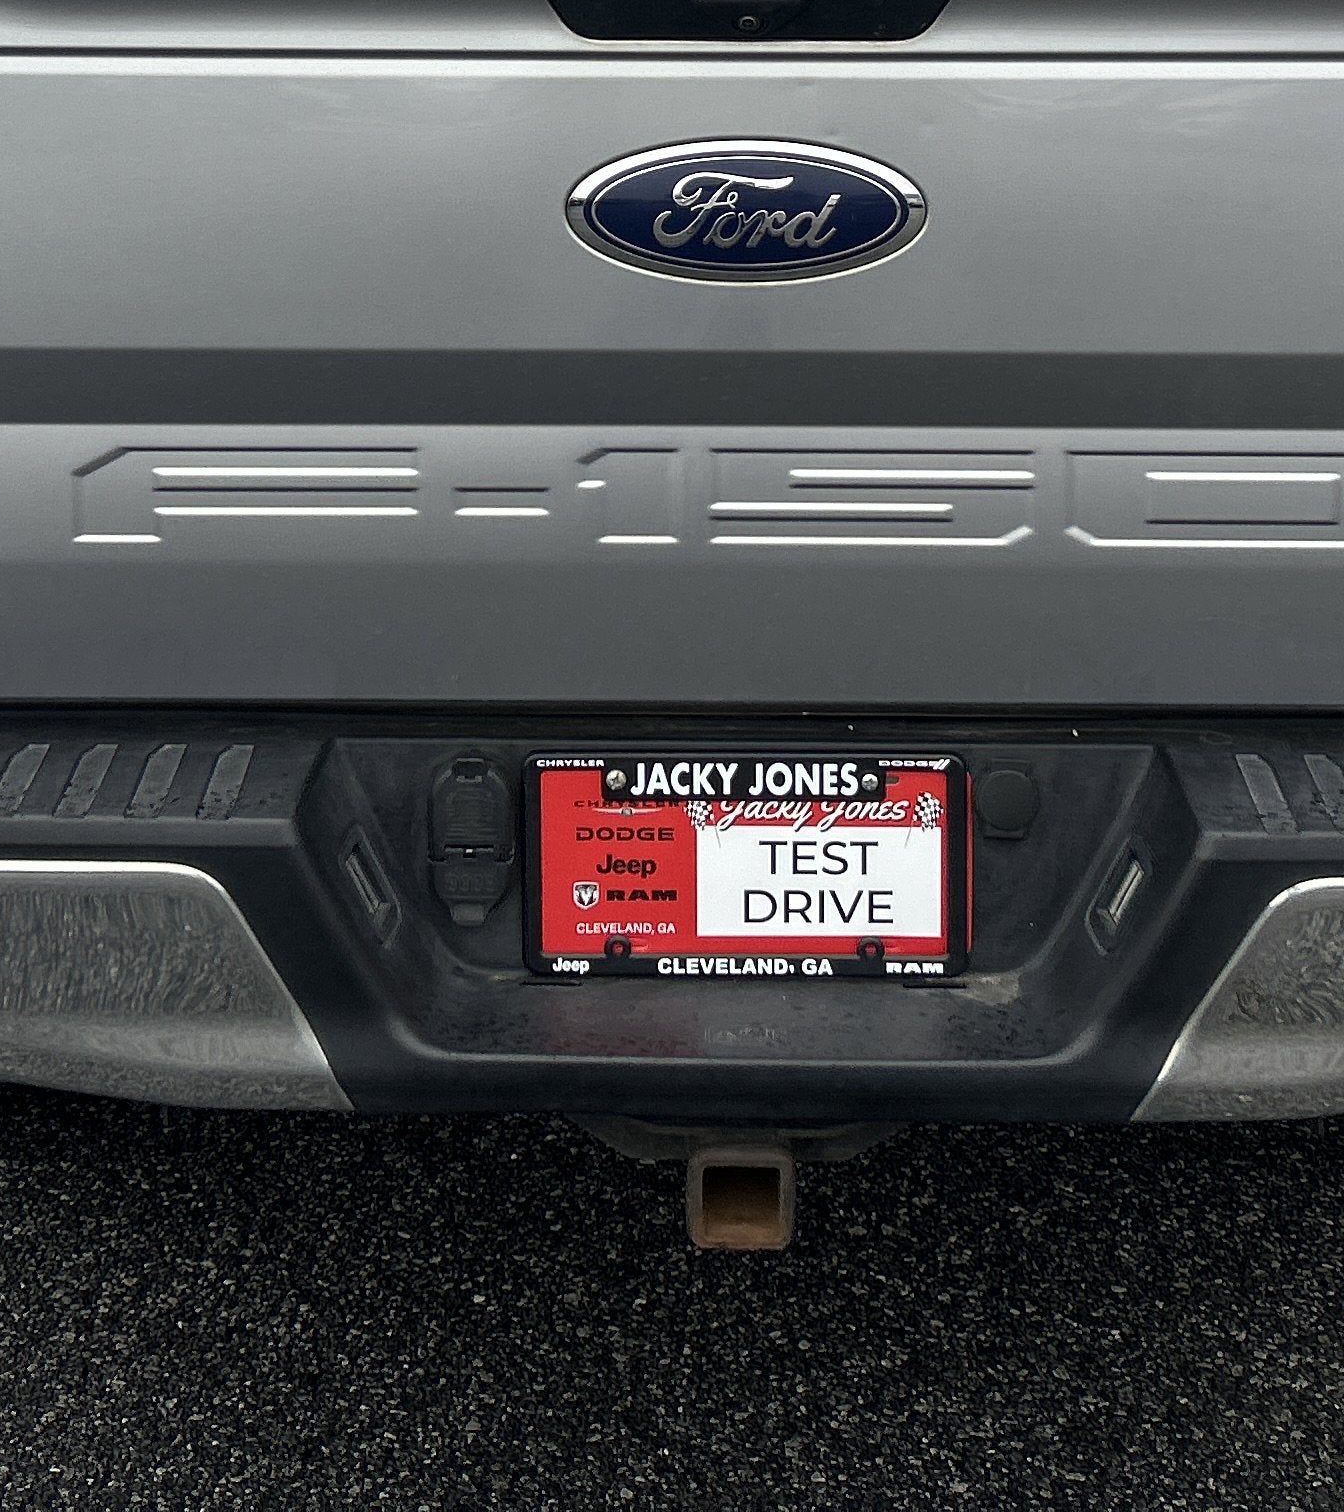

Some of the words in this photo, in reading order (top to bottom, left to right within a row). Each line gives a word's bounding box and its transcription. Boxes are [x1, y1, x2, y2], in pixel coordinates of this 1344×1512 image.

[652, 170, 843, 250] Ford
[536, 759, 605, 768] CHRYSLER
[629, 761, 740, 796] JACKY
[748, 761, 859, 796] JONES
[575, 826, 676, 842] DODGE
[595, 853, 657, 879] Jeep
[758, 839, 879, 876] TEST
[606, 889, 678, 902] RAM
[742, 888, 894, 925] DRIVE
[575, 921, 655, 936] CLEVELAND,
[657, 921, 676, 935] GA
[551, 956, 590, 975] Jeep
[801, 957, 834, 976] GA
[885, 962, 944, 974] RAM
